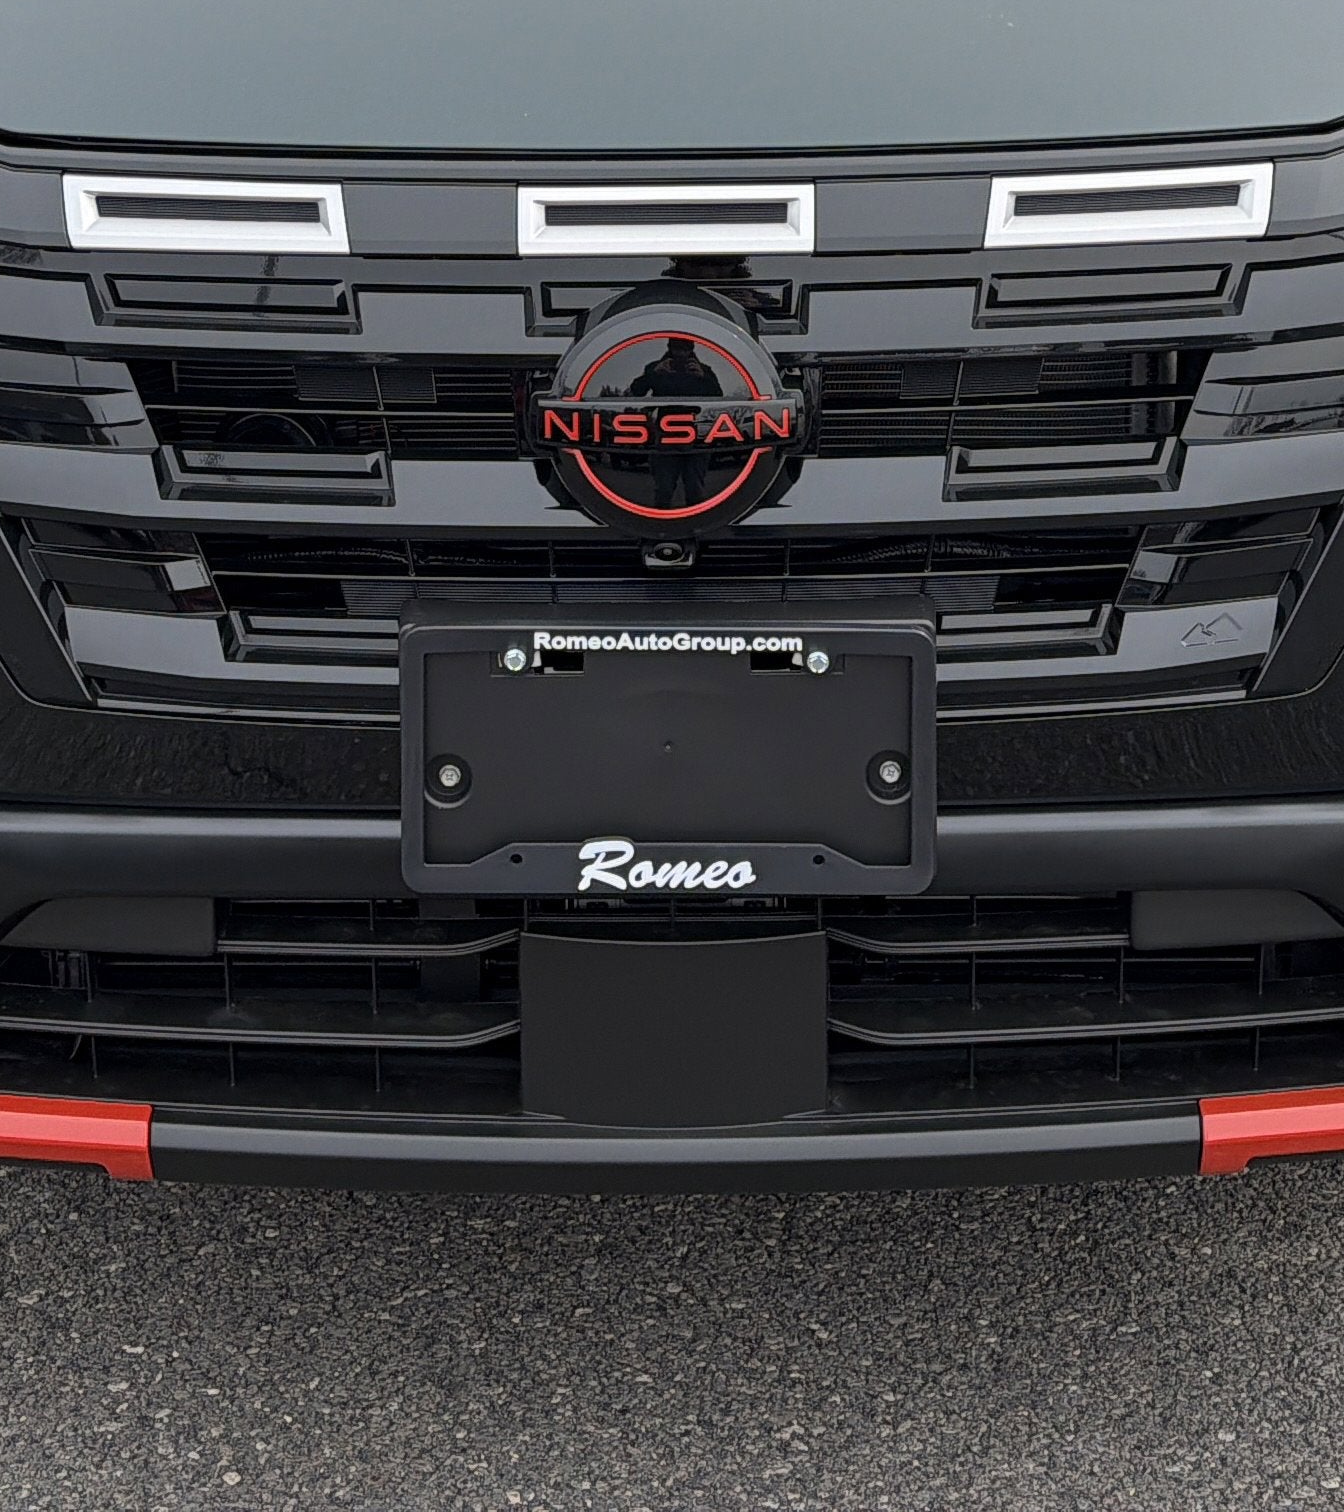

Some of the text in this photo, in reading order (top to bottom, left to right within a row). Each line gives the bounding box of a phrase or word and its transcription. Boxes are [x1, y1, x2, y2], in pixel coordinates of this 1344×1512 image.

[544, 408, 791, 444] NISSAN
[533, 631, 804, 654] RomeoAutoGroup.com
[577, 839, 757, 891] Romeo
